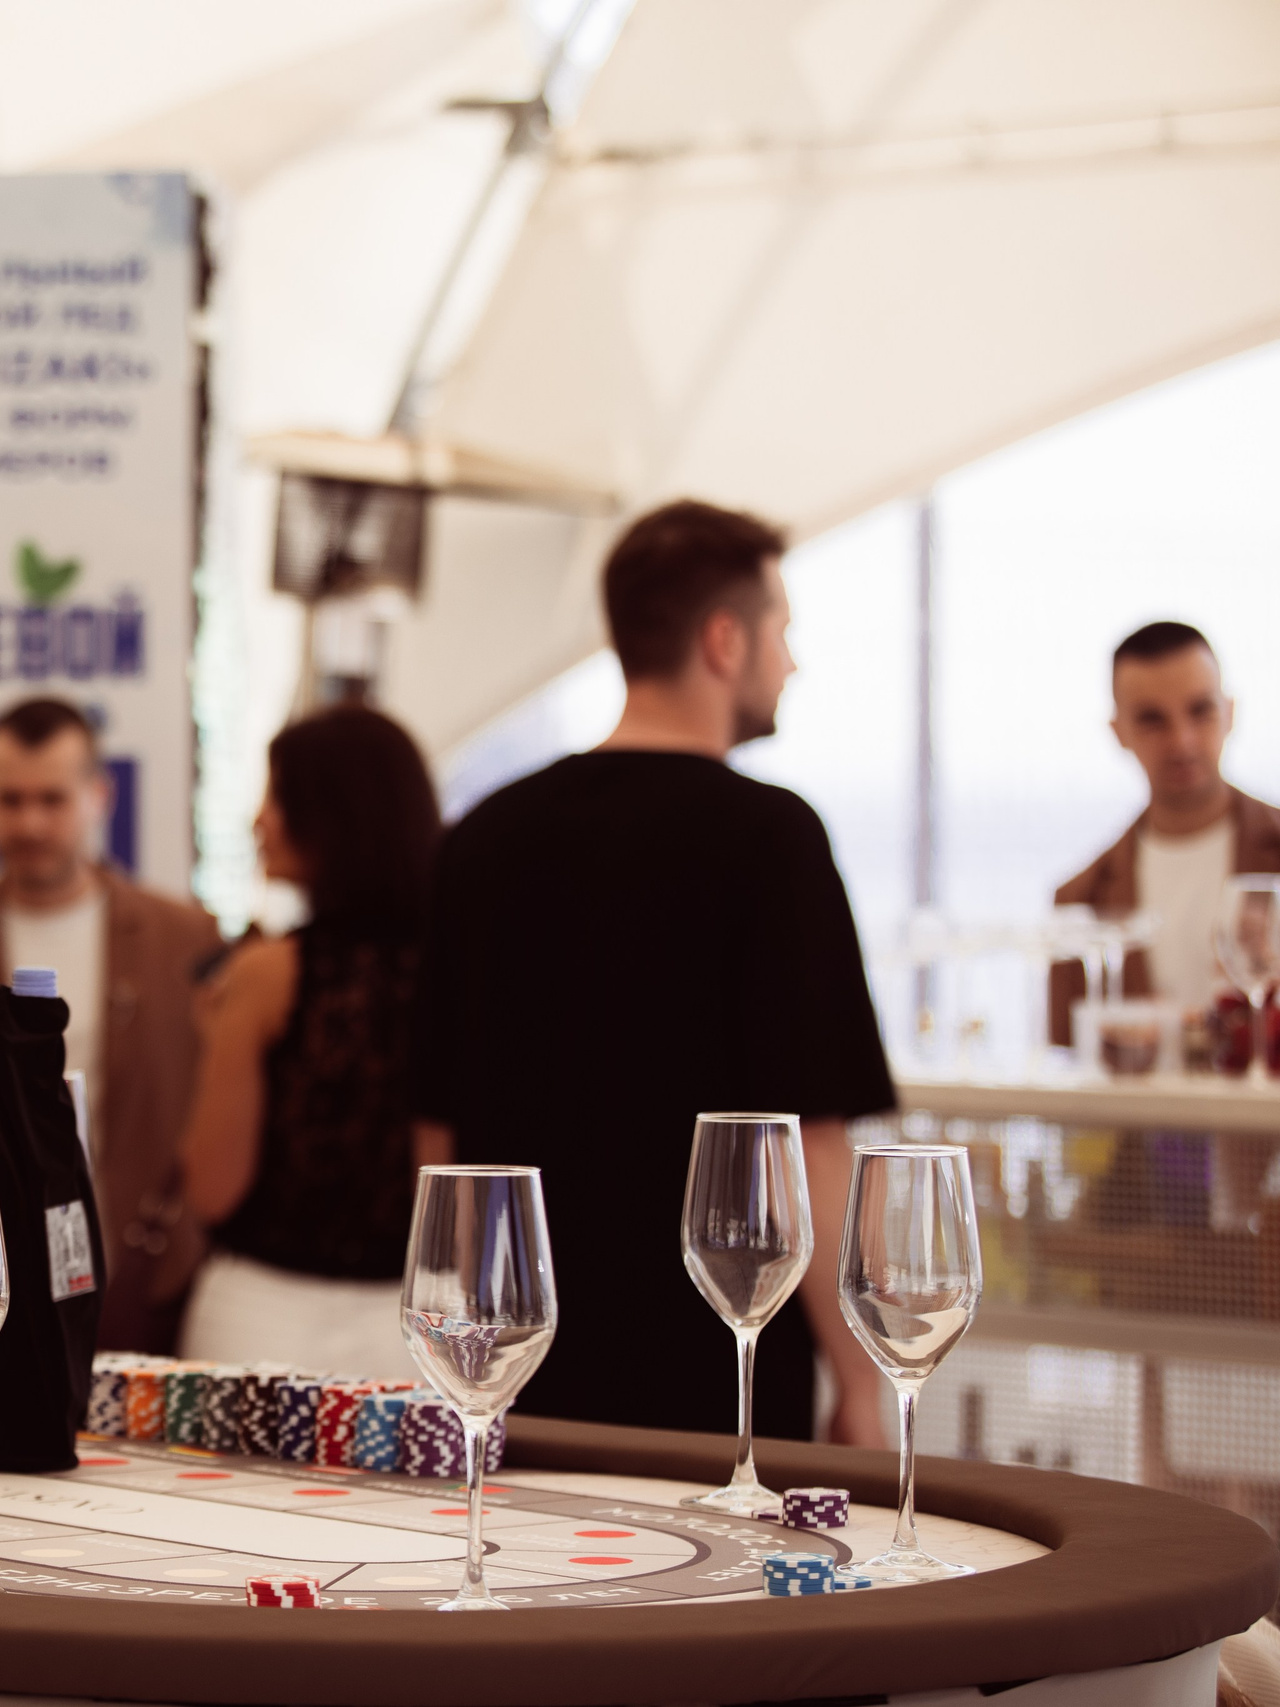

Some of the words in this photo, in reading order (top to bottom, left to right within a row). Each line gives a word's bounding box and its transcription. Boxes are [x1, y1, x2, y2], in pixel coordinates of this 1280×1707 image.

[593, 1507, 787, 1546] МОЛОДОЕ
[696, 1565, 761, 1581] ЛЕТ
[547, 1587, 641, 1601] ЛЕТ
